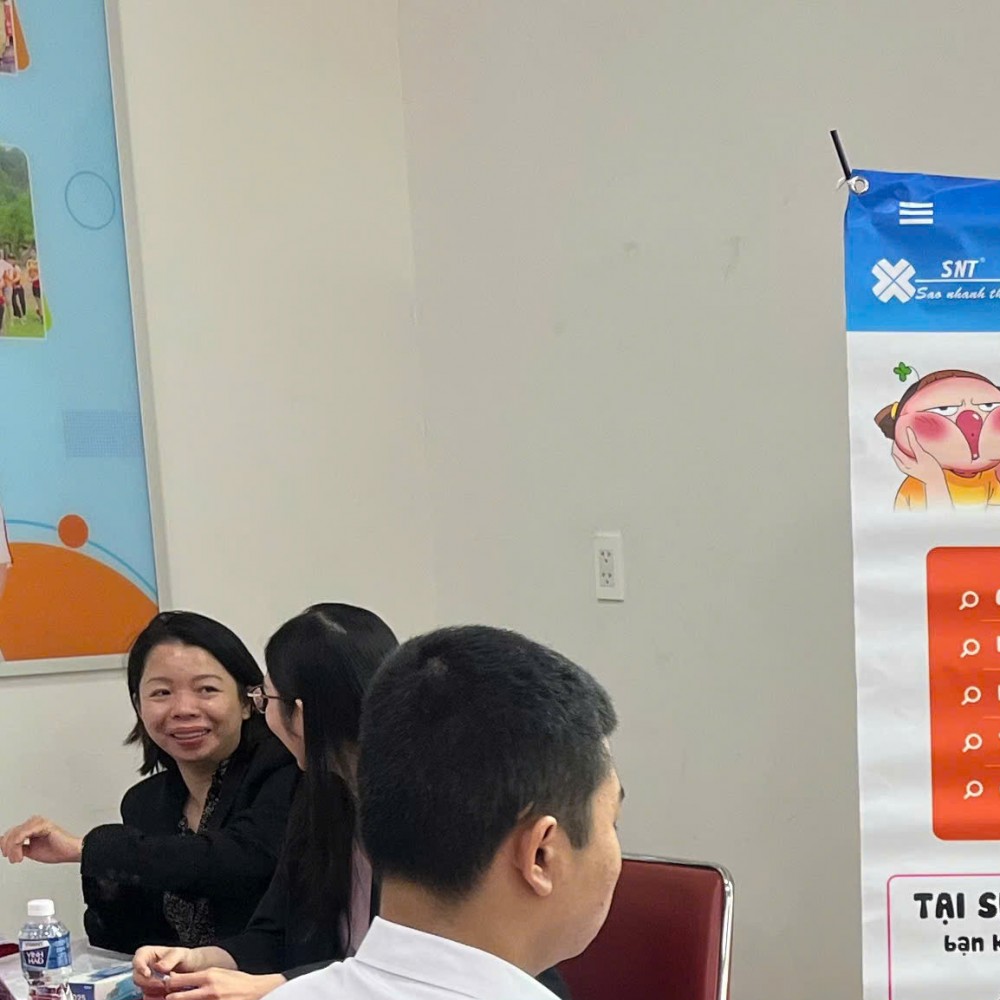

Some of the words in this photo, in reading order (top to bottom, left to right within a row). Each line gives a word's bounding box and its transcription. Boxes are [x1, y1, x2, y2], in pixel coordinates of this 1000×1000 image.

[915, 287, 943, 300] Sao
[946, 287, 987, 300] nhanh
[913, 892, 965, 926] TẠI
[944, 935, 984, 957] bạn
